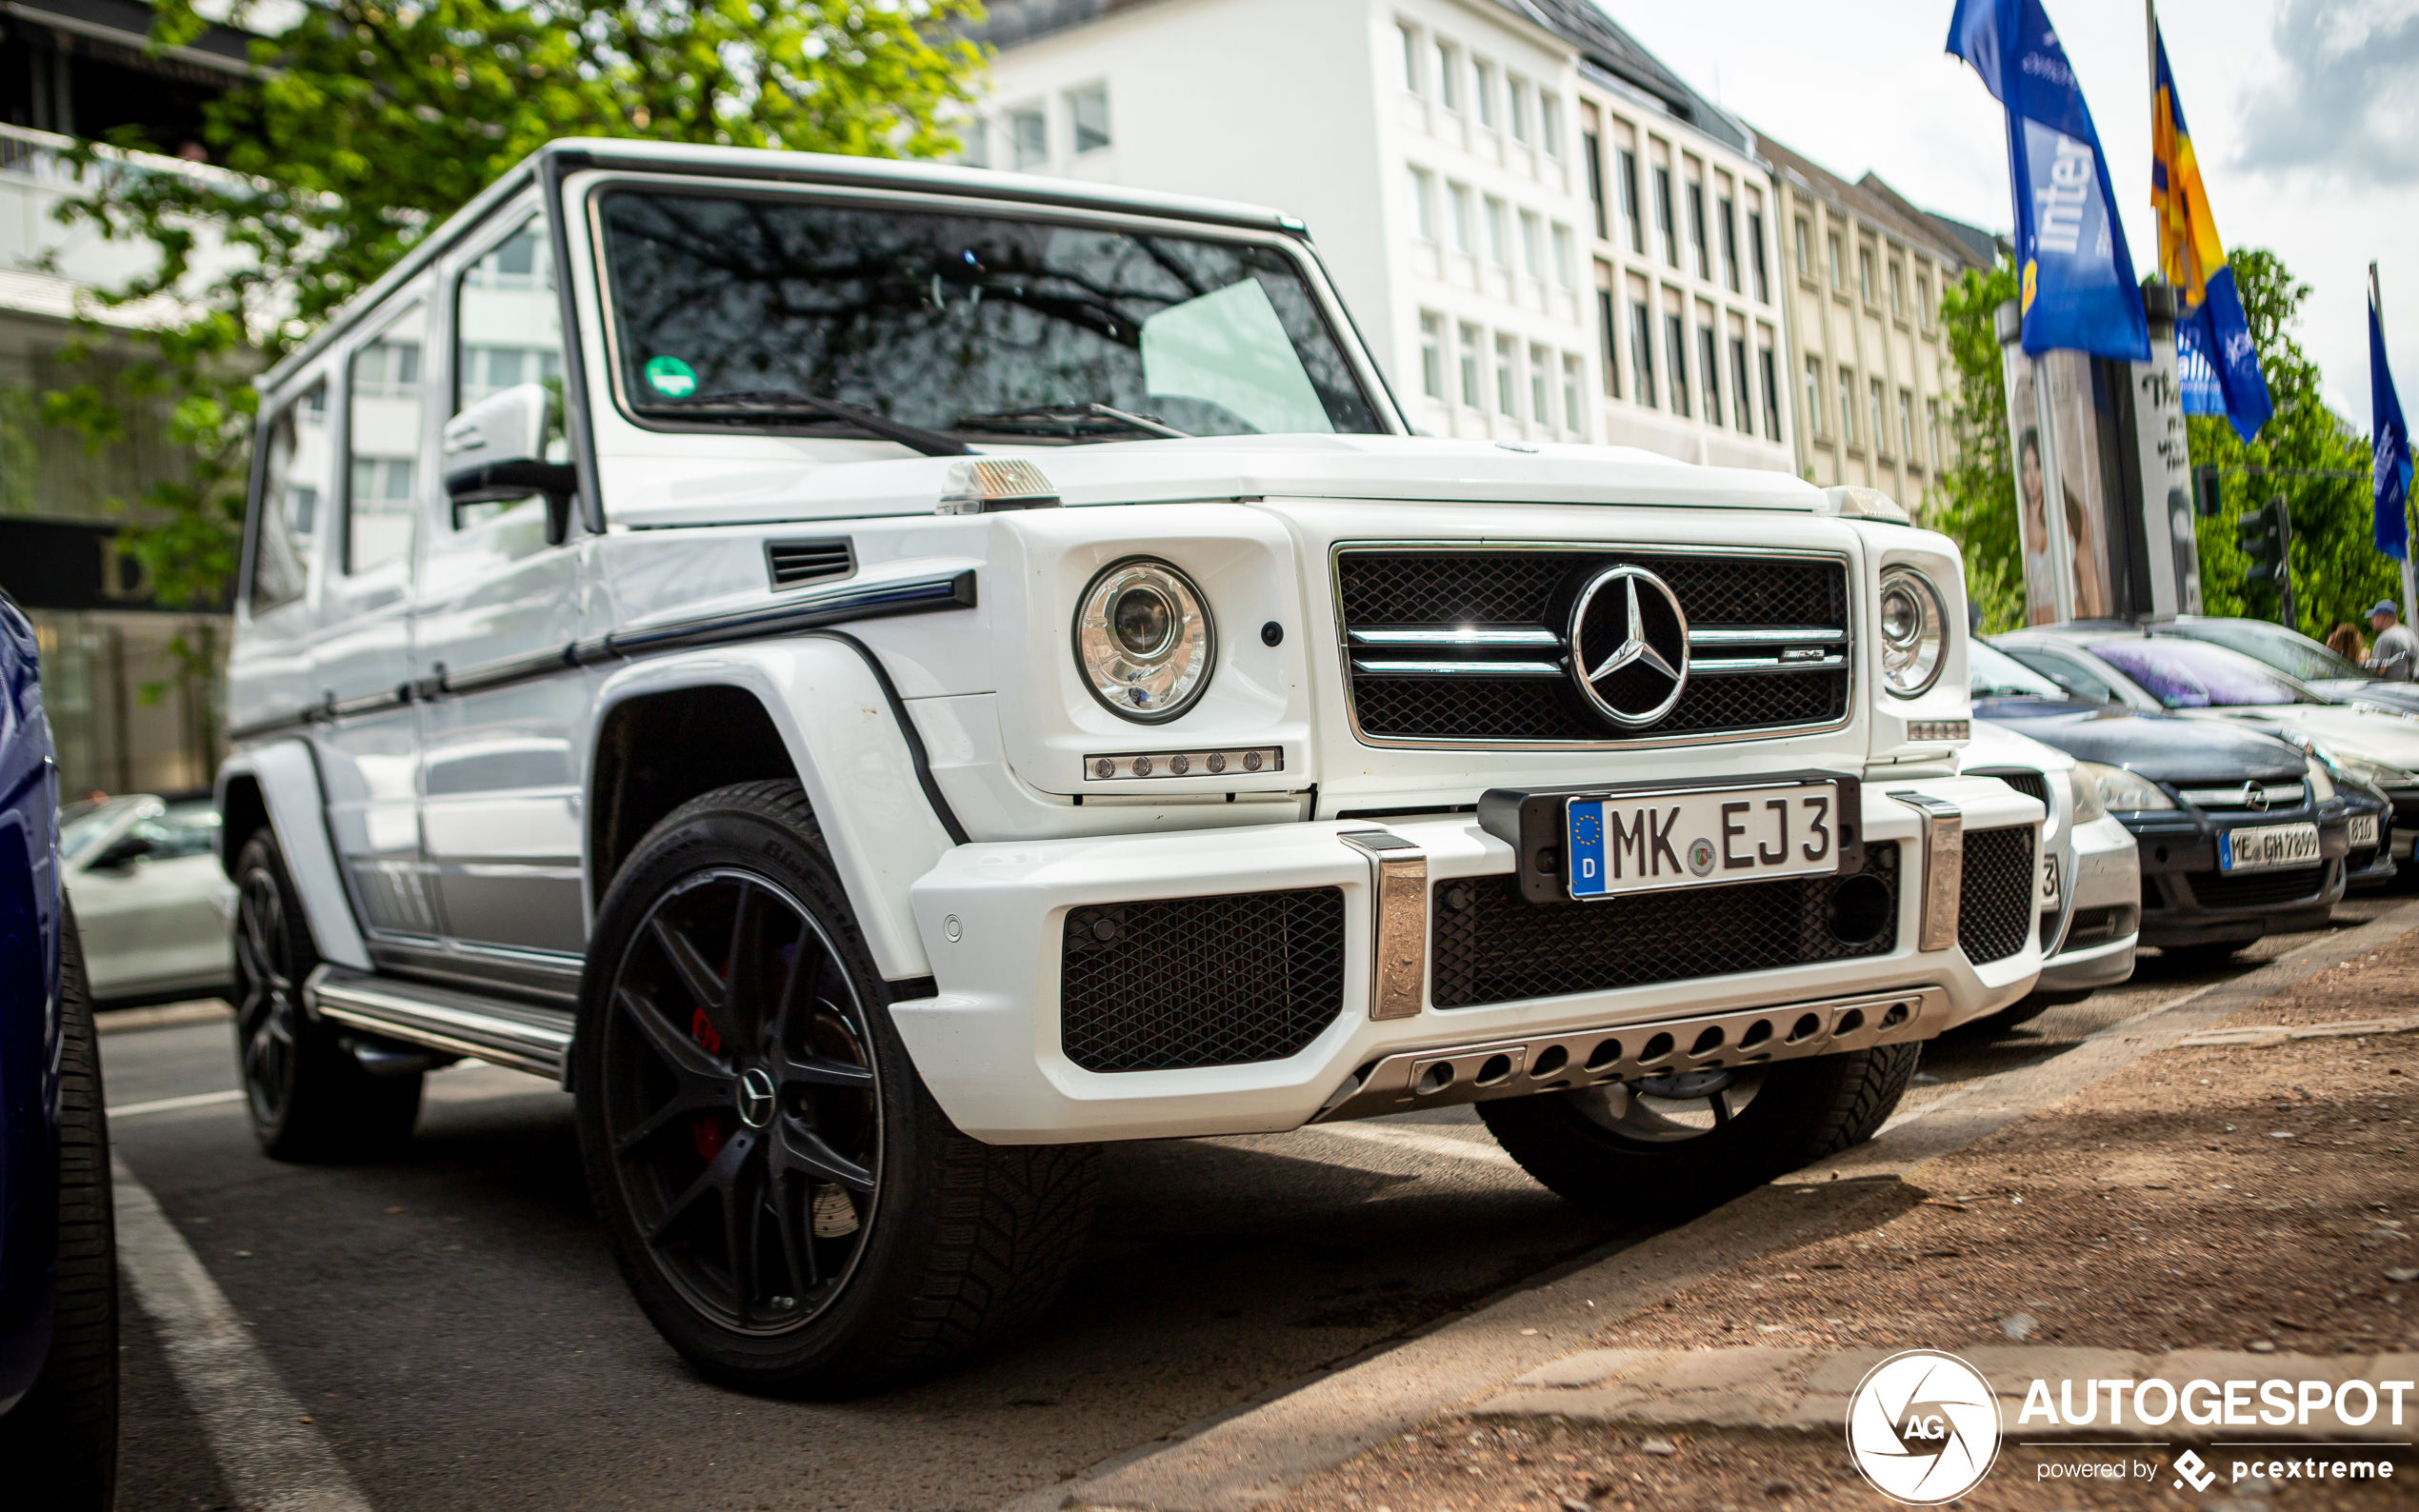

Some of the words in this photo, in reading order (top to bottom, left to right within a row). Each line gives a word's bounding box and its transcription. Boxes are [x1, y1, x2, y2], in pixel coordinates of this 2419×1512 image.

[1611, 806, 1683, 879] MK
[1721, 799, 1789, 870] EJ
[1803, 796, 1829, 862] 3
[1582, 857, 1596, 879] D
